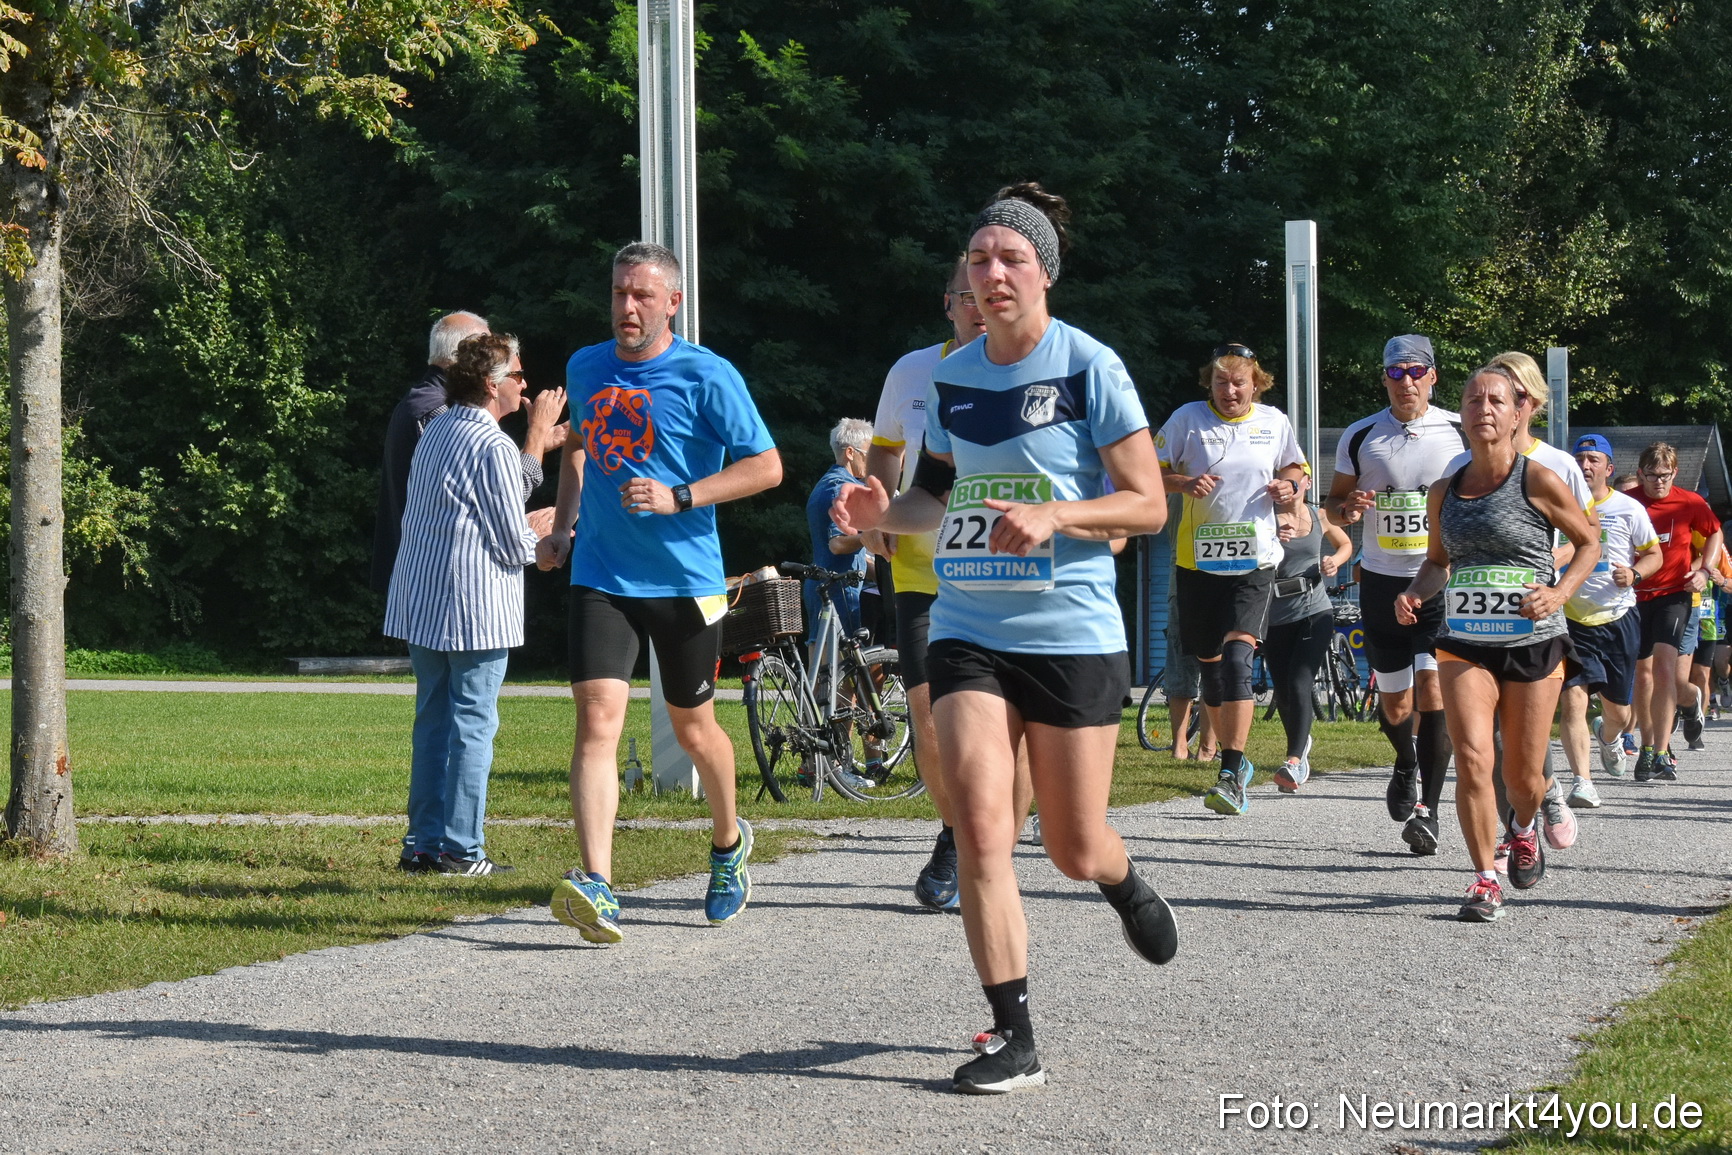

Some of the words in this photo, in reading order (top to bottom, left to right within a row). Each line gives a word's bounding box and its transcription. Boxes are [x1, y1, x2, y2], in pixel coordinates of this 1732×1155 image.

[606, 398, 643, 427] CHALLENGE
[613, 429, 632, 437] ROTH
[954, 480, 1039, 505] BOCK
[946, 515, 1004, 550] 22
[1199, 526, 1250, 537] BOCK
[1201, 540, 1250, 558] 2752
[1391, 538, 1425, 548] Rainer
[943, 561, 1040, 577] CHRISTINA
[1456, 570, 1524, 584] BOCK
[1455, 591, 1523, 615] 2329
[1464, 622, 1514, 632] SABINE
